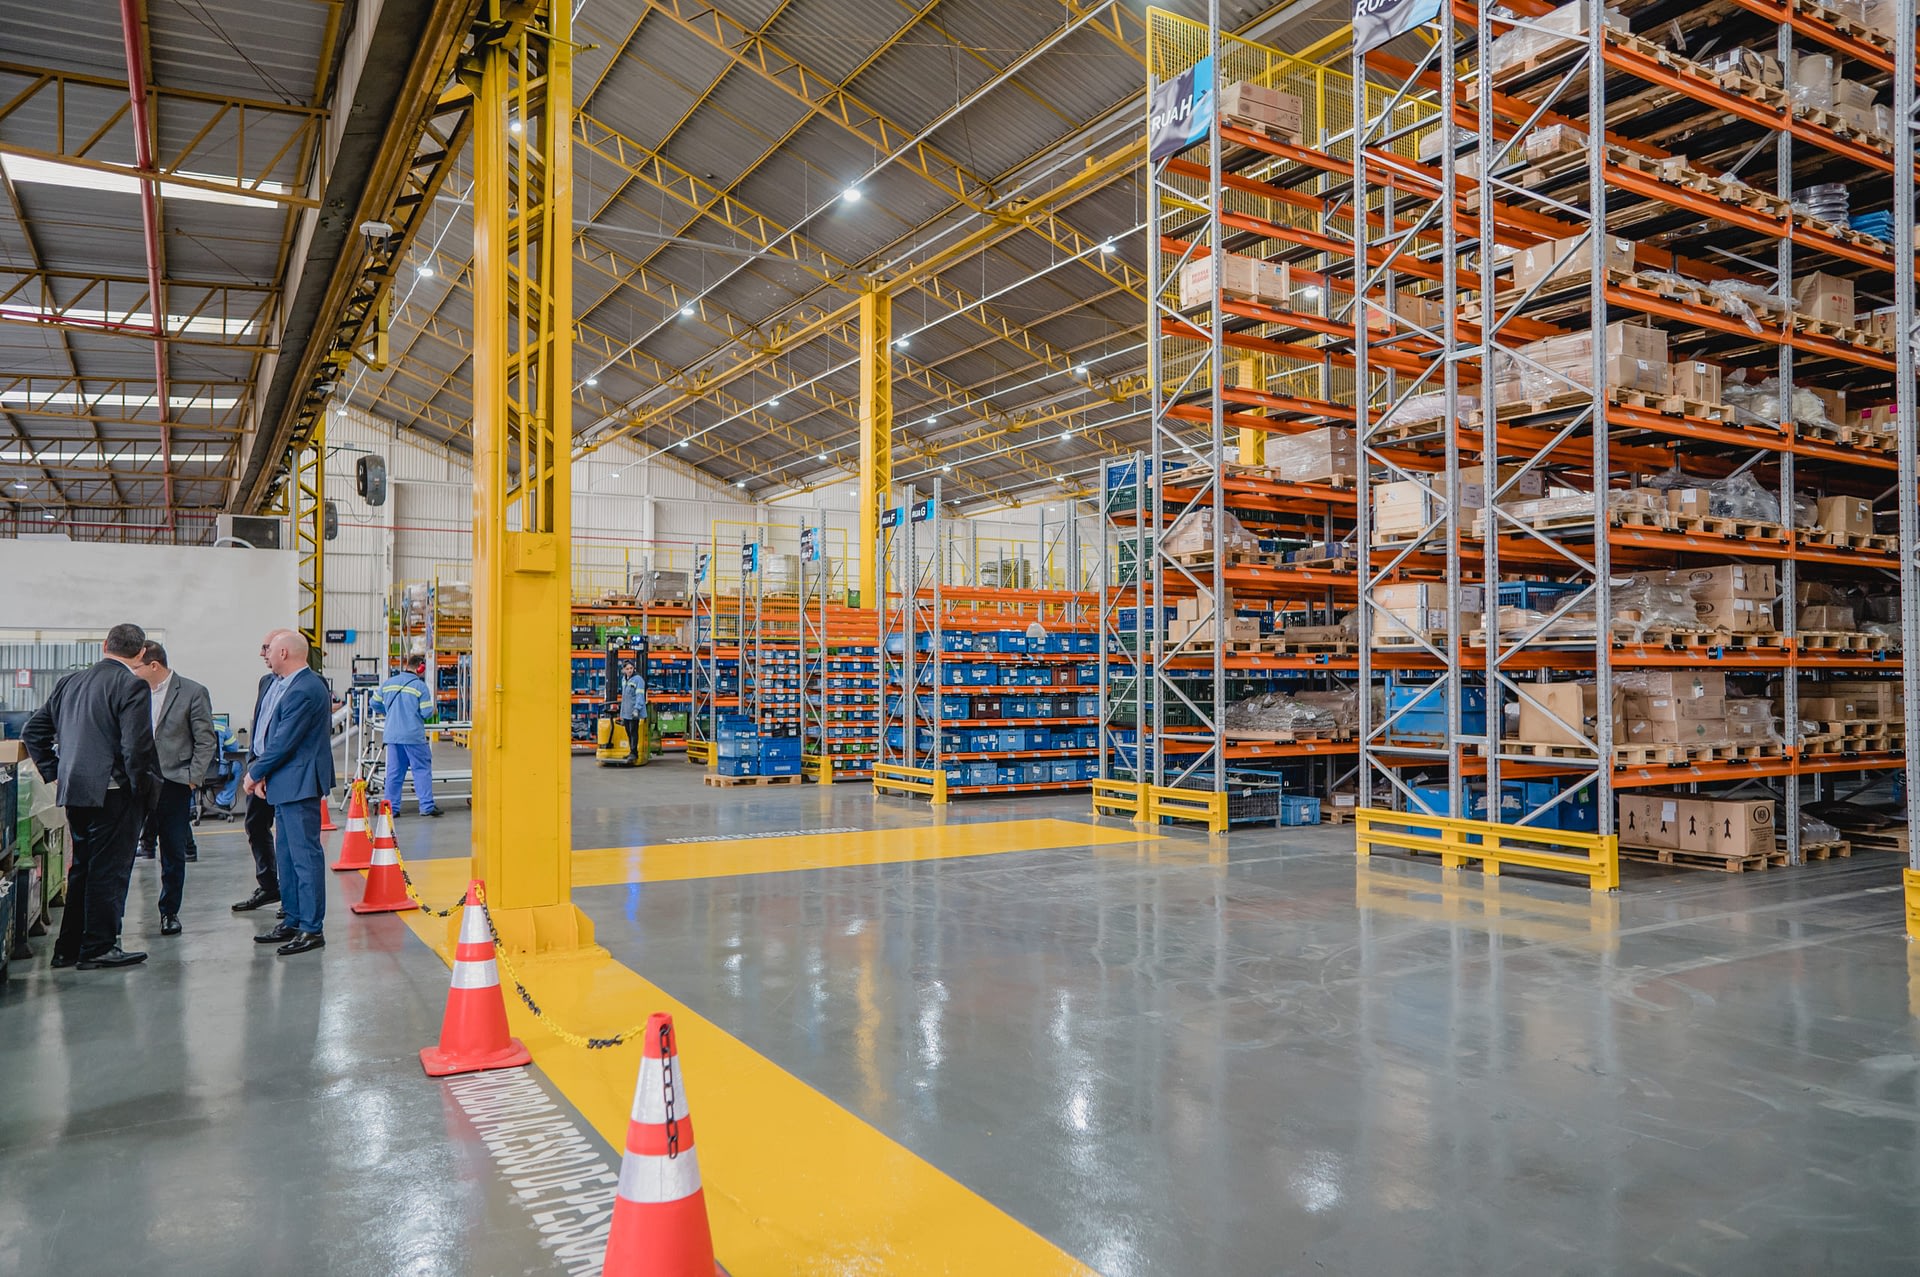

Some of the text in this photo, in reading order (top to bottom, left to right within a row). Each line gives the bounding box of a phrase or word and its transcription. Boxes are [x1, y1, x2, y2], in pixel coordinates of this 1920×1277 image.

[443, 1066, 618, 1277] PROIBIDO ACESSO DE PESSO
